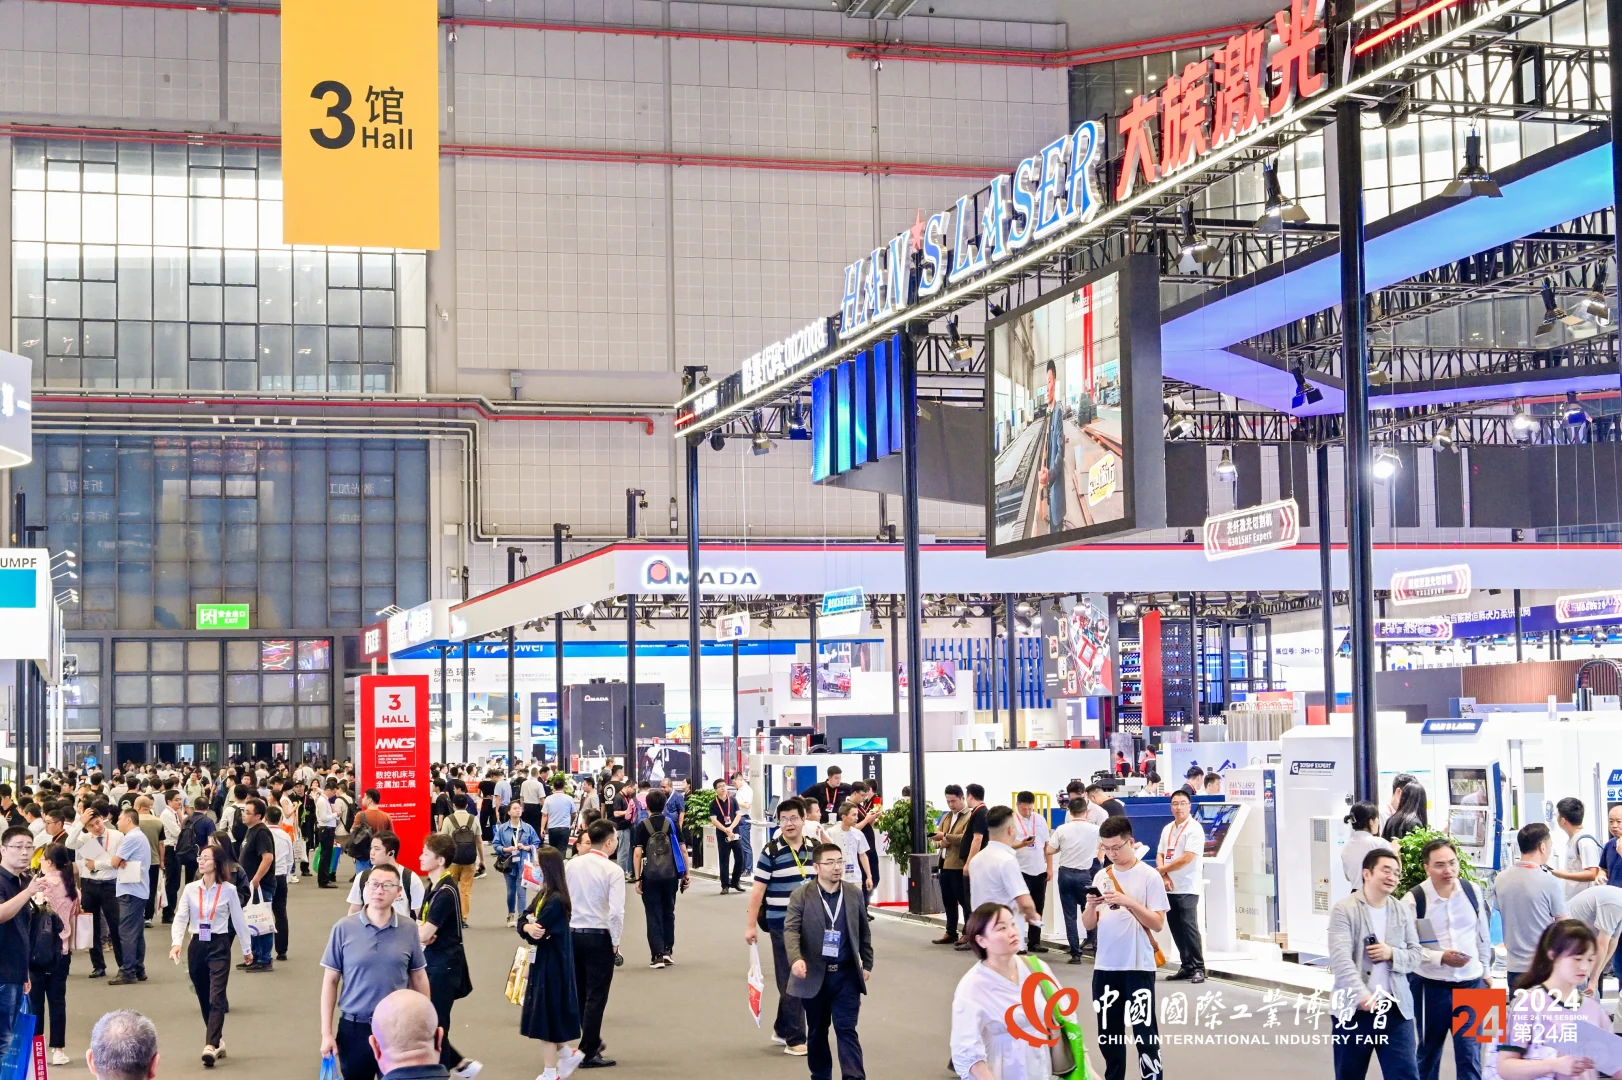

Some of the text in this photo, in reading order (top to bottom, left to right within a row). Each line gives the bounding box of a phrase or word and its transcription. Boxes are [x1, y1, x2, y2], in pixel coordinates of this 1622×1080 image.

[365, 85, 404, 125] 馆
[1115, 0, 1325, 201] 大族激光
[309, 80, 356, 150] 3
[362, 127, 413, 151] Hall
[949, 120, 1101, 284] LASER
[1253, 531, 1272, 544] Expert
[0, 557, 37, 568] UMPF
[388, 694, 401, 711] 3
[382, 715, 409, 724] HALL
[375, 738, 416, 750] MWCS
[376, 771, 415, 779] 数控机床与
[376, 780, 416, 789] 金属加工展
